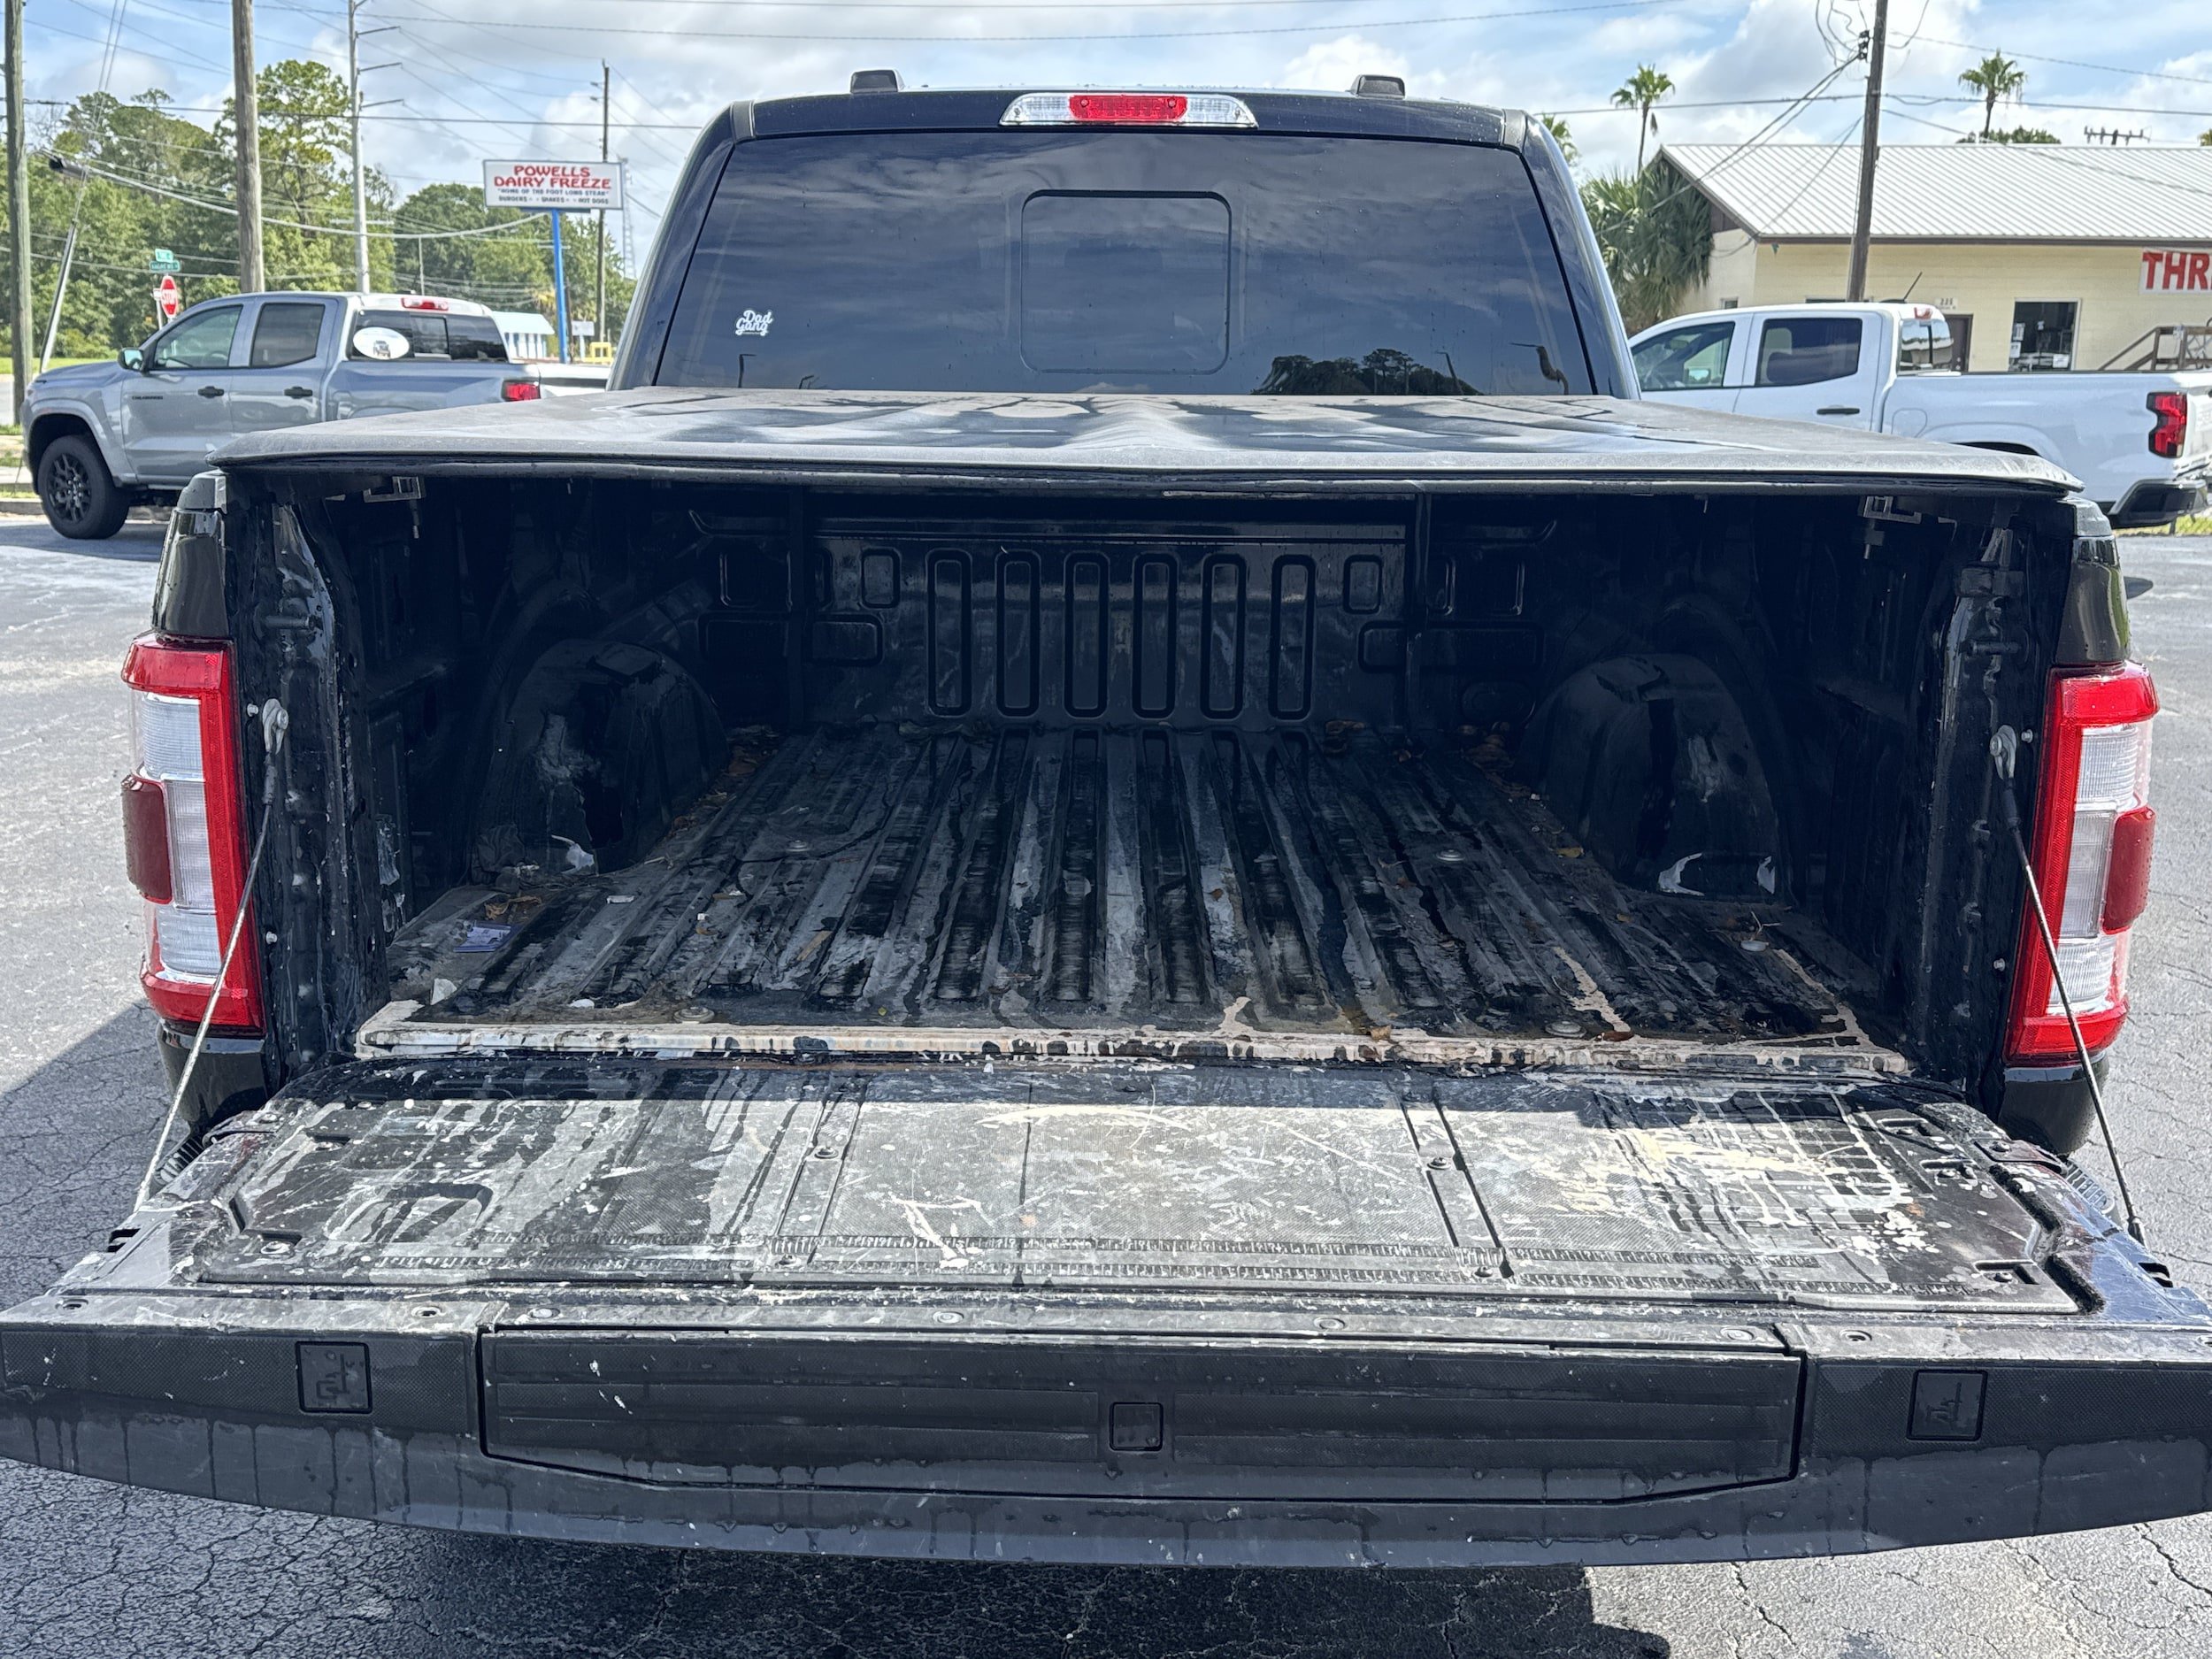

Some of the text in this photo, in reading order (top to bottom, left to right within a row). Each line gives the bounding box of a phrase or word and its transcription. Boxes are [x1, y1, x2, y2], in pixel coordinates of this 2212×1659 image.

[513, 165, 591, 177] POWELLS
[494, 176, 611, 189] DAIRY FREEZE
[2142, 251, 2212, 290] THR
[162, 288, 177, 305] STOP
[743, 310, 773, 324] Dad
[735, 318, 768, 336] Gang
